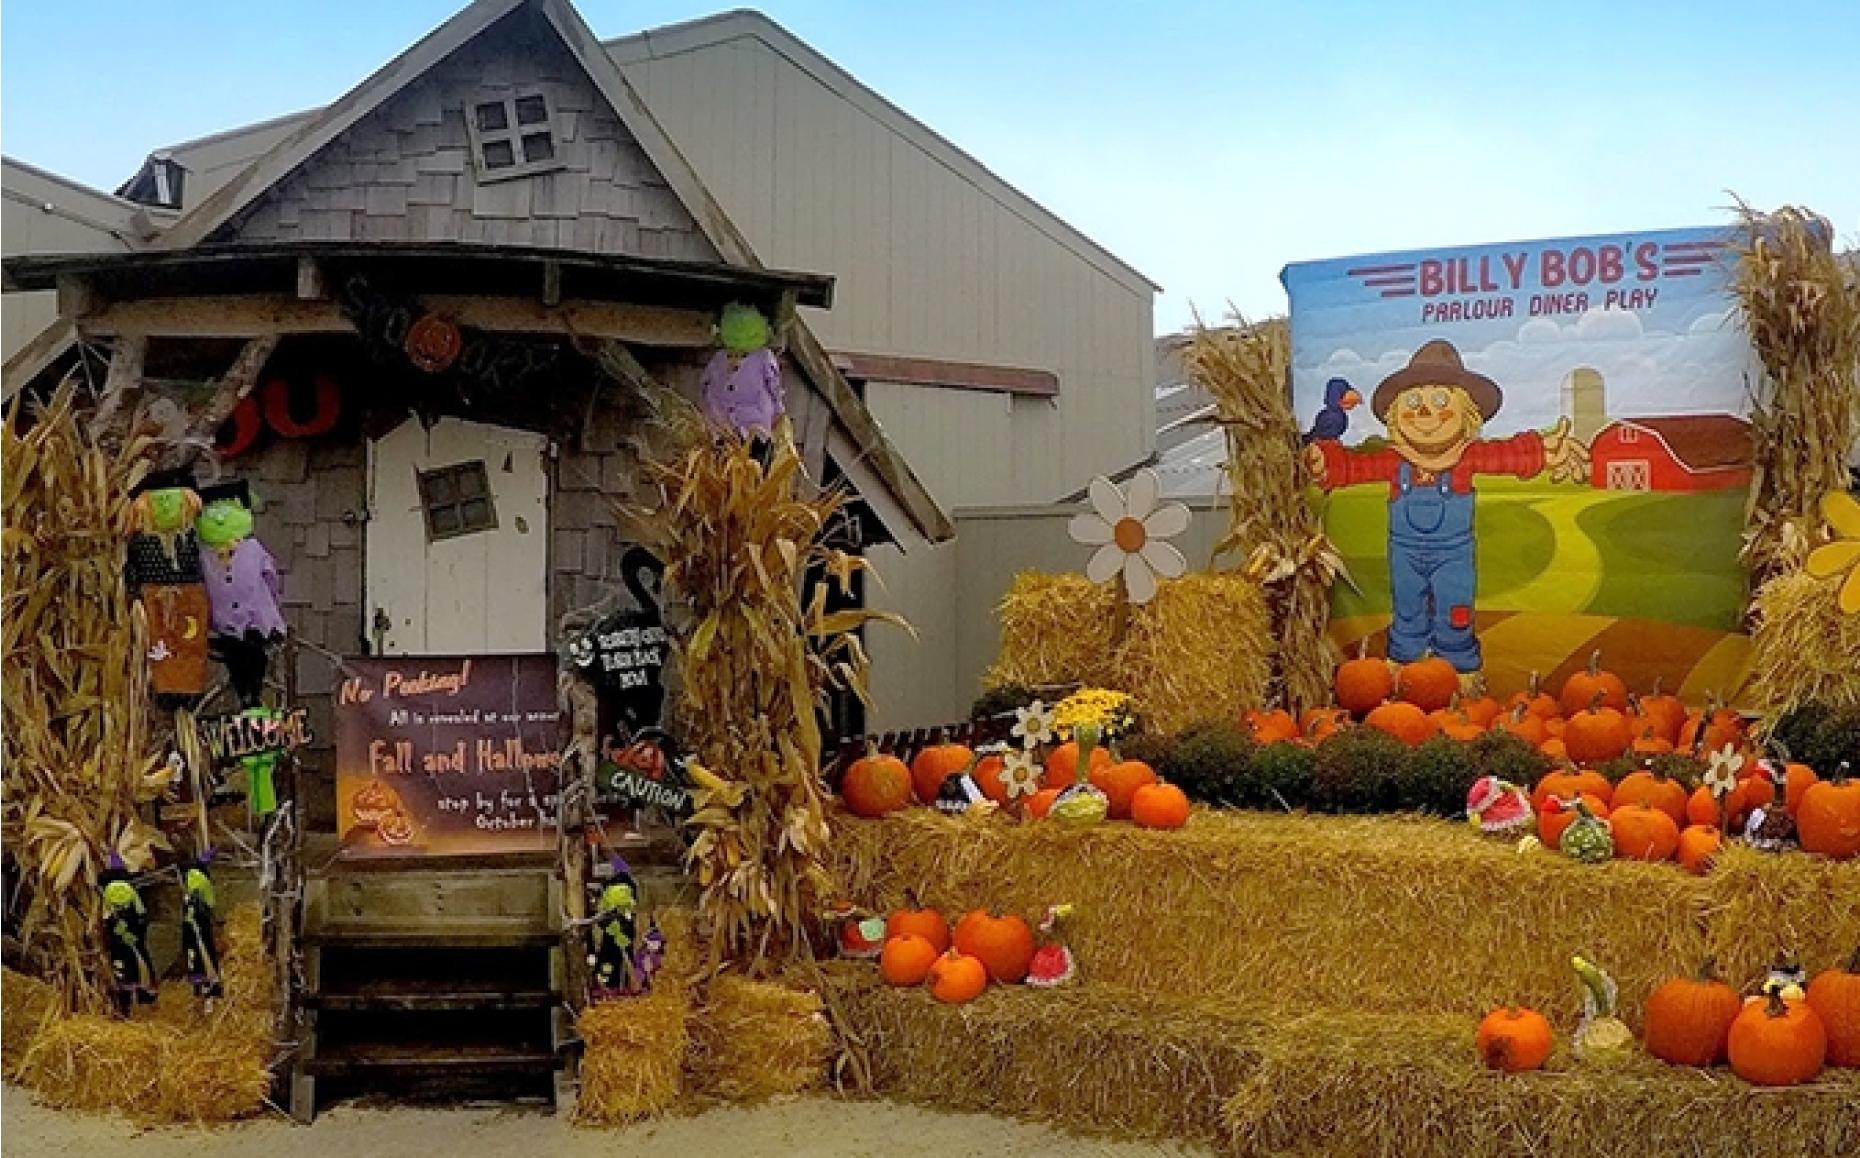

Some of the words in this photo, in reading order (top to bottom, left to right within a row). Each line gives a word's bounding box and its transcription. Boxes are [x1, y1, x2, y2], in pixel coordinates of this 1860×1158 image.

[1419, 251, 1528, 296] BILLY
[1540, 240, 1660, 287] BOB'S
[1421, 296, 1514, 323] PARLOUR
[1529, 293, 1588, 317] DINER
[1604, 288, 1660, 312] PLAY
[340, 676, 375, 705] No
[368, 739, 413, 775] Fall
[423, 739, 467, 774] and
[476, 737, 560, 777] Hallowe
[610, 772, 688, 811] CAUTION
